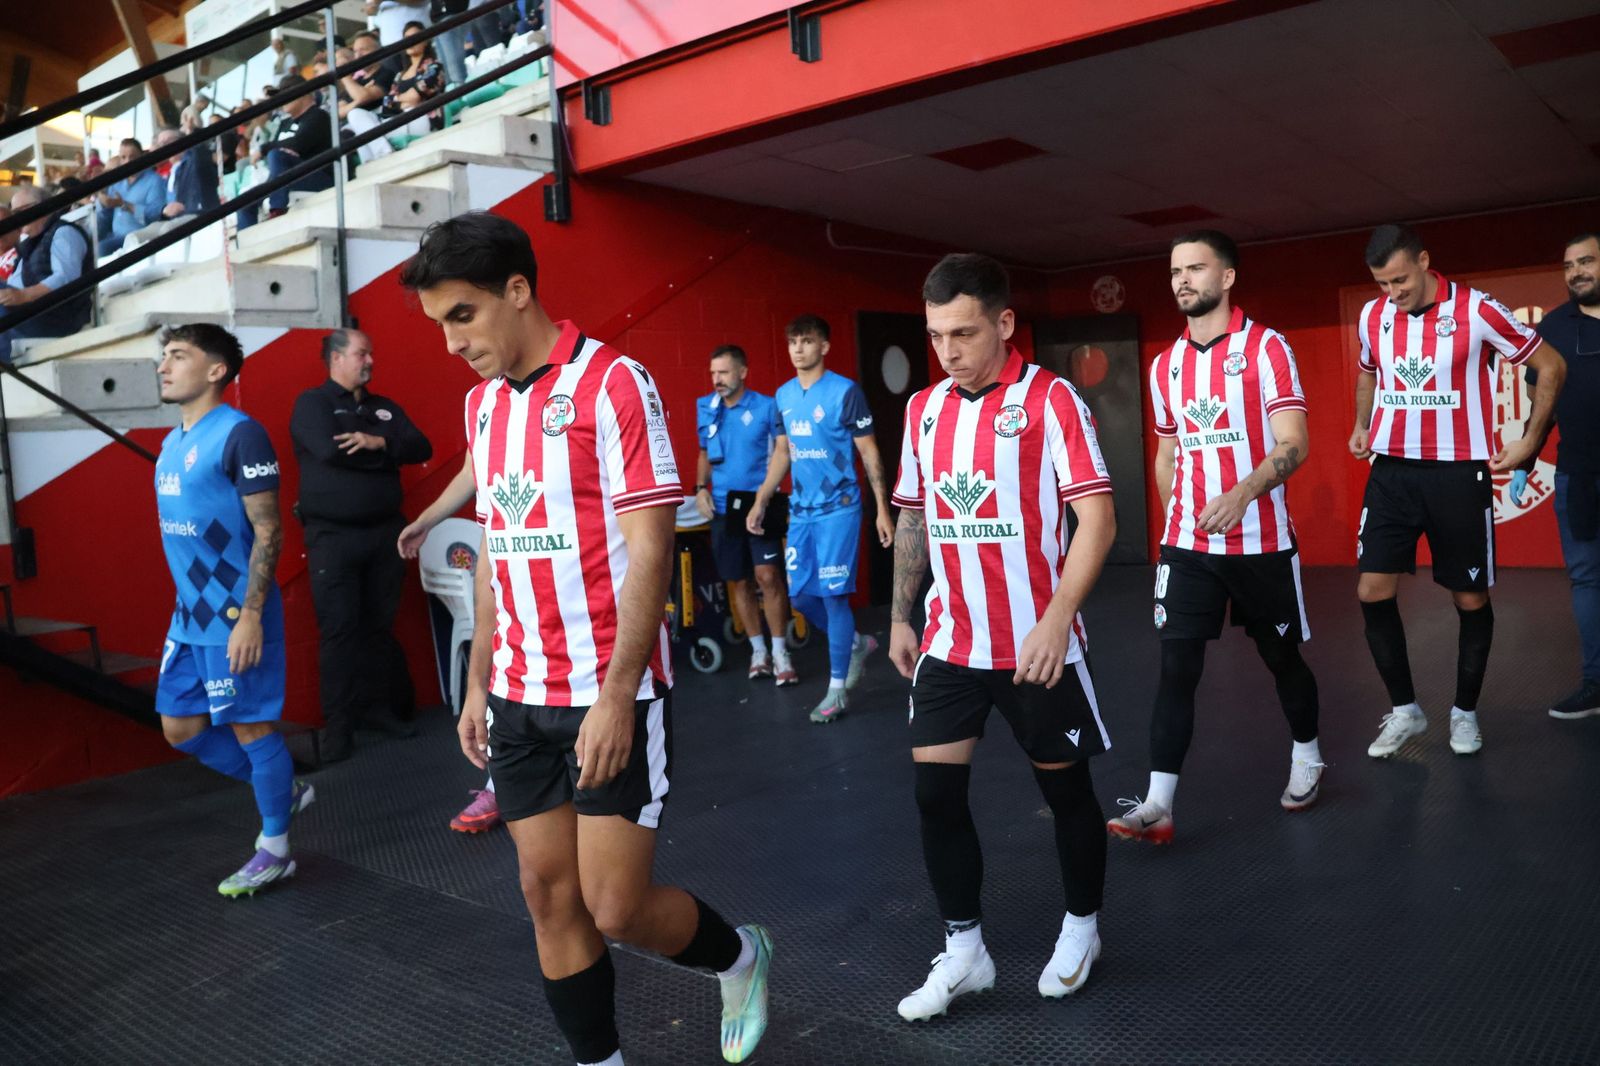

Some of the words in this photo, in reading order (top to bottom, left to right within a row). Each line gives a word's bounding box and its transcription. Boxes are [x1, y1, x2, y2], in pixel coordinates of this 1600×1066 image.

[1383, 394, 1407, 406] CAJA
[1410, 394, 1456, 406] RURAL
[856, 415, 873, 429] bb
[1205, 431, 1245, 445] RURAL
[930, 524, 958, 539] CAJA
[961, 523, 1019, 538] RURAL
[489, 536, 509, 554] AJA
[511, 533, 572, 553] RURAL
